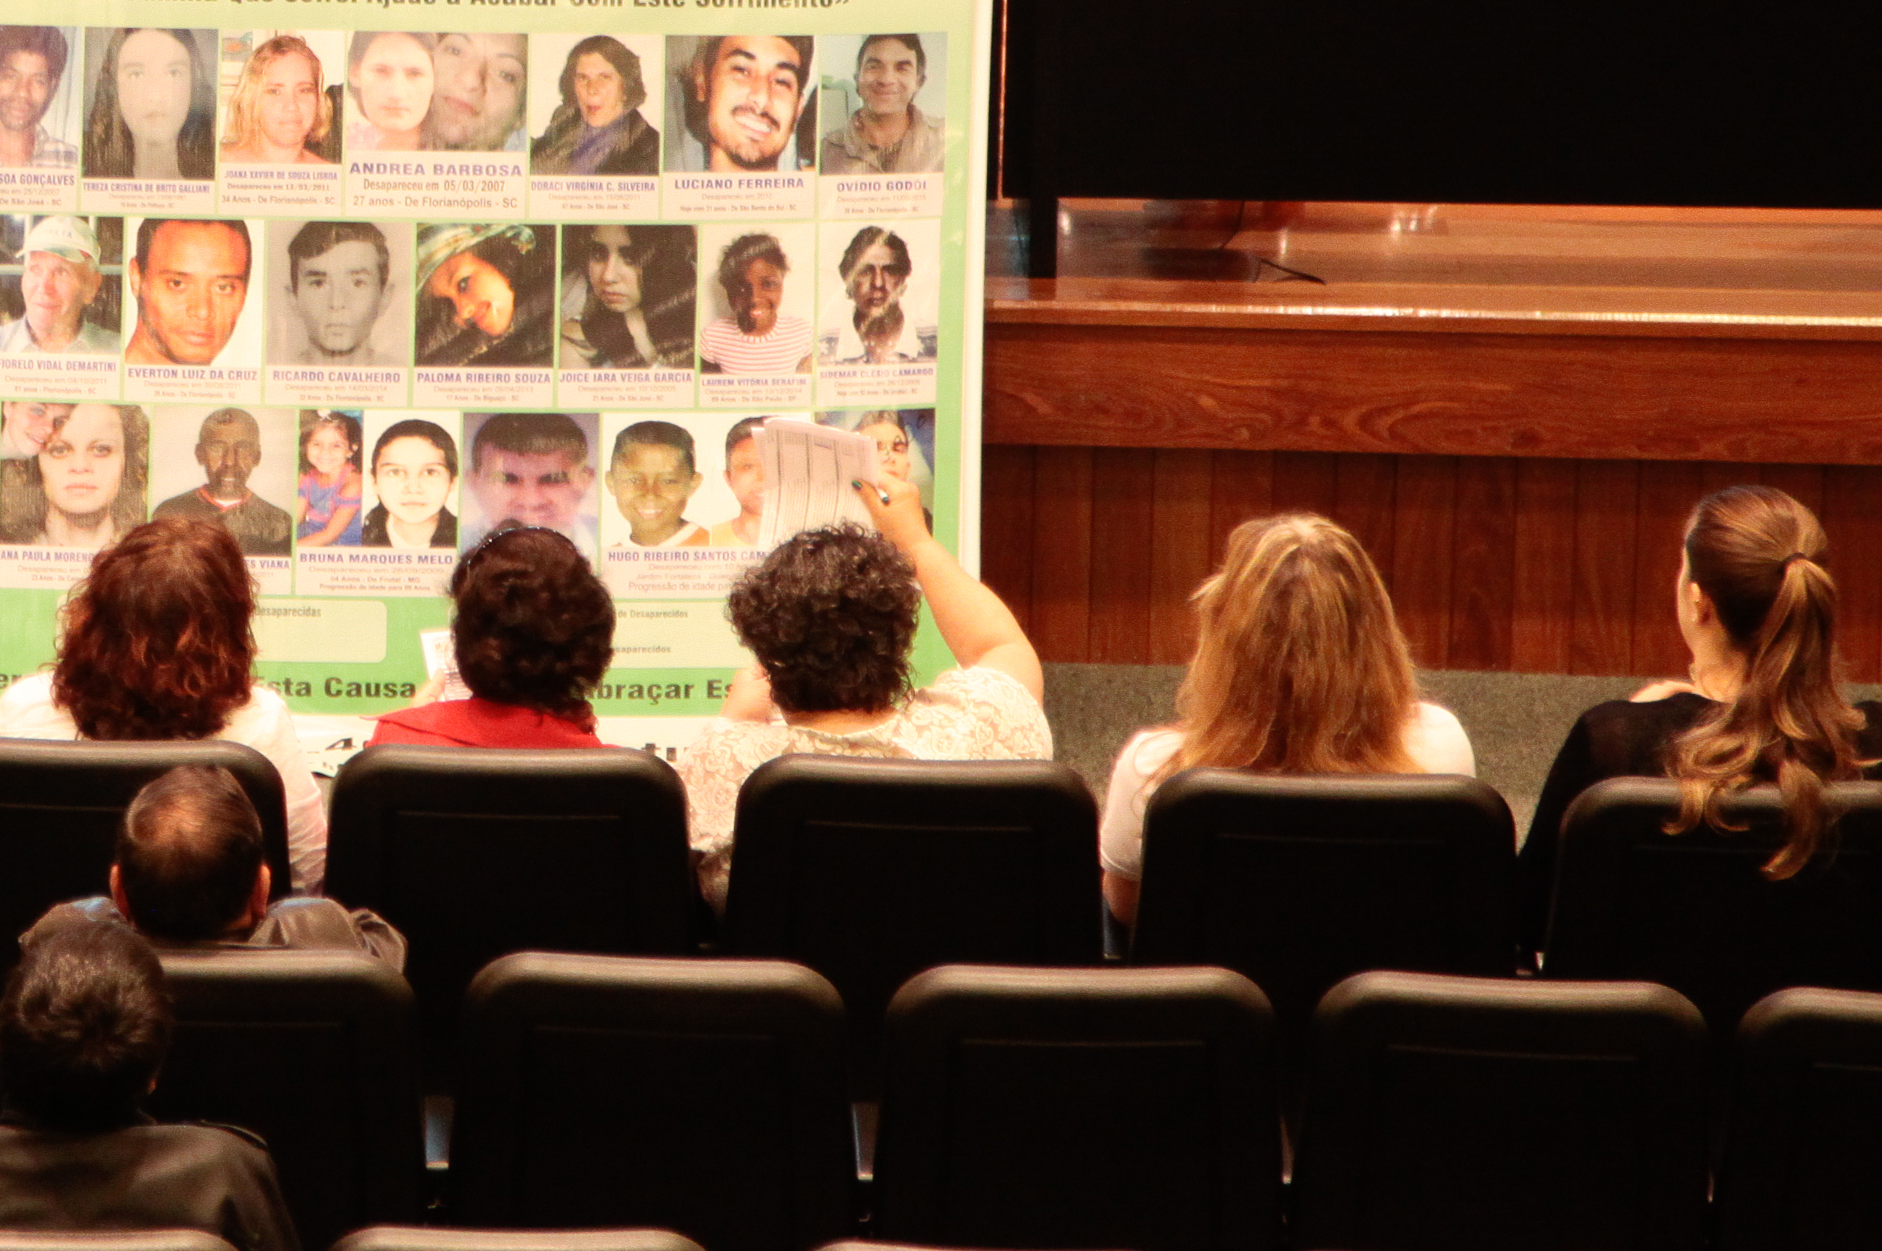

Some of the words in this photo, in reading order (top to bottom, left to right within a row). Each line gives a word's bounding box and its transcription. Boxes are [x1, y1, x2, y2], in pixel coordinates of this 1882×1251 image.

[350, 163, 425, 175] ANDREA
[433, 164, 522, 177] BARBOSA
[20, 173, 75, 187] GONÇALVES
[363, 179, 420, 192] Desapareceu
[422, 182, 439, 191] em
[443, 180, 505, 192] 05/03/2007
[674, 179, 733, 190] LUCIANO
[738, 178, 804, 190] FERREIRA
[837, 178, 881, 192] OVÍDIO
[618, 181, 655, 192] SILVEIRA
[353, 196, 365, 206] 27
[368, 198, 394, 207] anos
[405, 196, 420, 207] De
[422, 196, 492, 209] Florianópolis
[502, 198, 517, 208] SC
[37, 359, 63, 371] VIDAL
[66, 360, 117, 372] DEMARTINI
[128, 368, 178, 380] EVERTON
[182, 369, 206, 380] LUIZ
[209, 370, 224, 380] DA
[227, 370, 258, 381] CRUZ
[273, 371, 324, 382] RICARDO
[328, 371, 401, 383] CAVALHEIRO
[417, 372, 462, 383] PALOMA
[466, 372, 511, 383] RIBEIRO
[515, 373, 551, 384] SOUZA
[559, 372, 590, 383] JOICE
[621, 372, 651, 383] VEIGA
[654, 372, 692, 383] GARCIA
[1, 550, 19, 560] ANA
[22, 551, 51, 561] PAULA
[300, 553, 343, 563] BRUNA
[349, 554, 412, 564] MARQUES
[417, 555, 453, 564] MELO
[608, 552, 640, 561] HUGO
[644, 552, 689, 561] RIBEIRO
[693, 551, 736, 561] SANTOS
[630, 609, 689, 619] Desaparecidos
[324, 677, 416, 699] Causa
